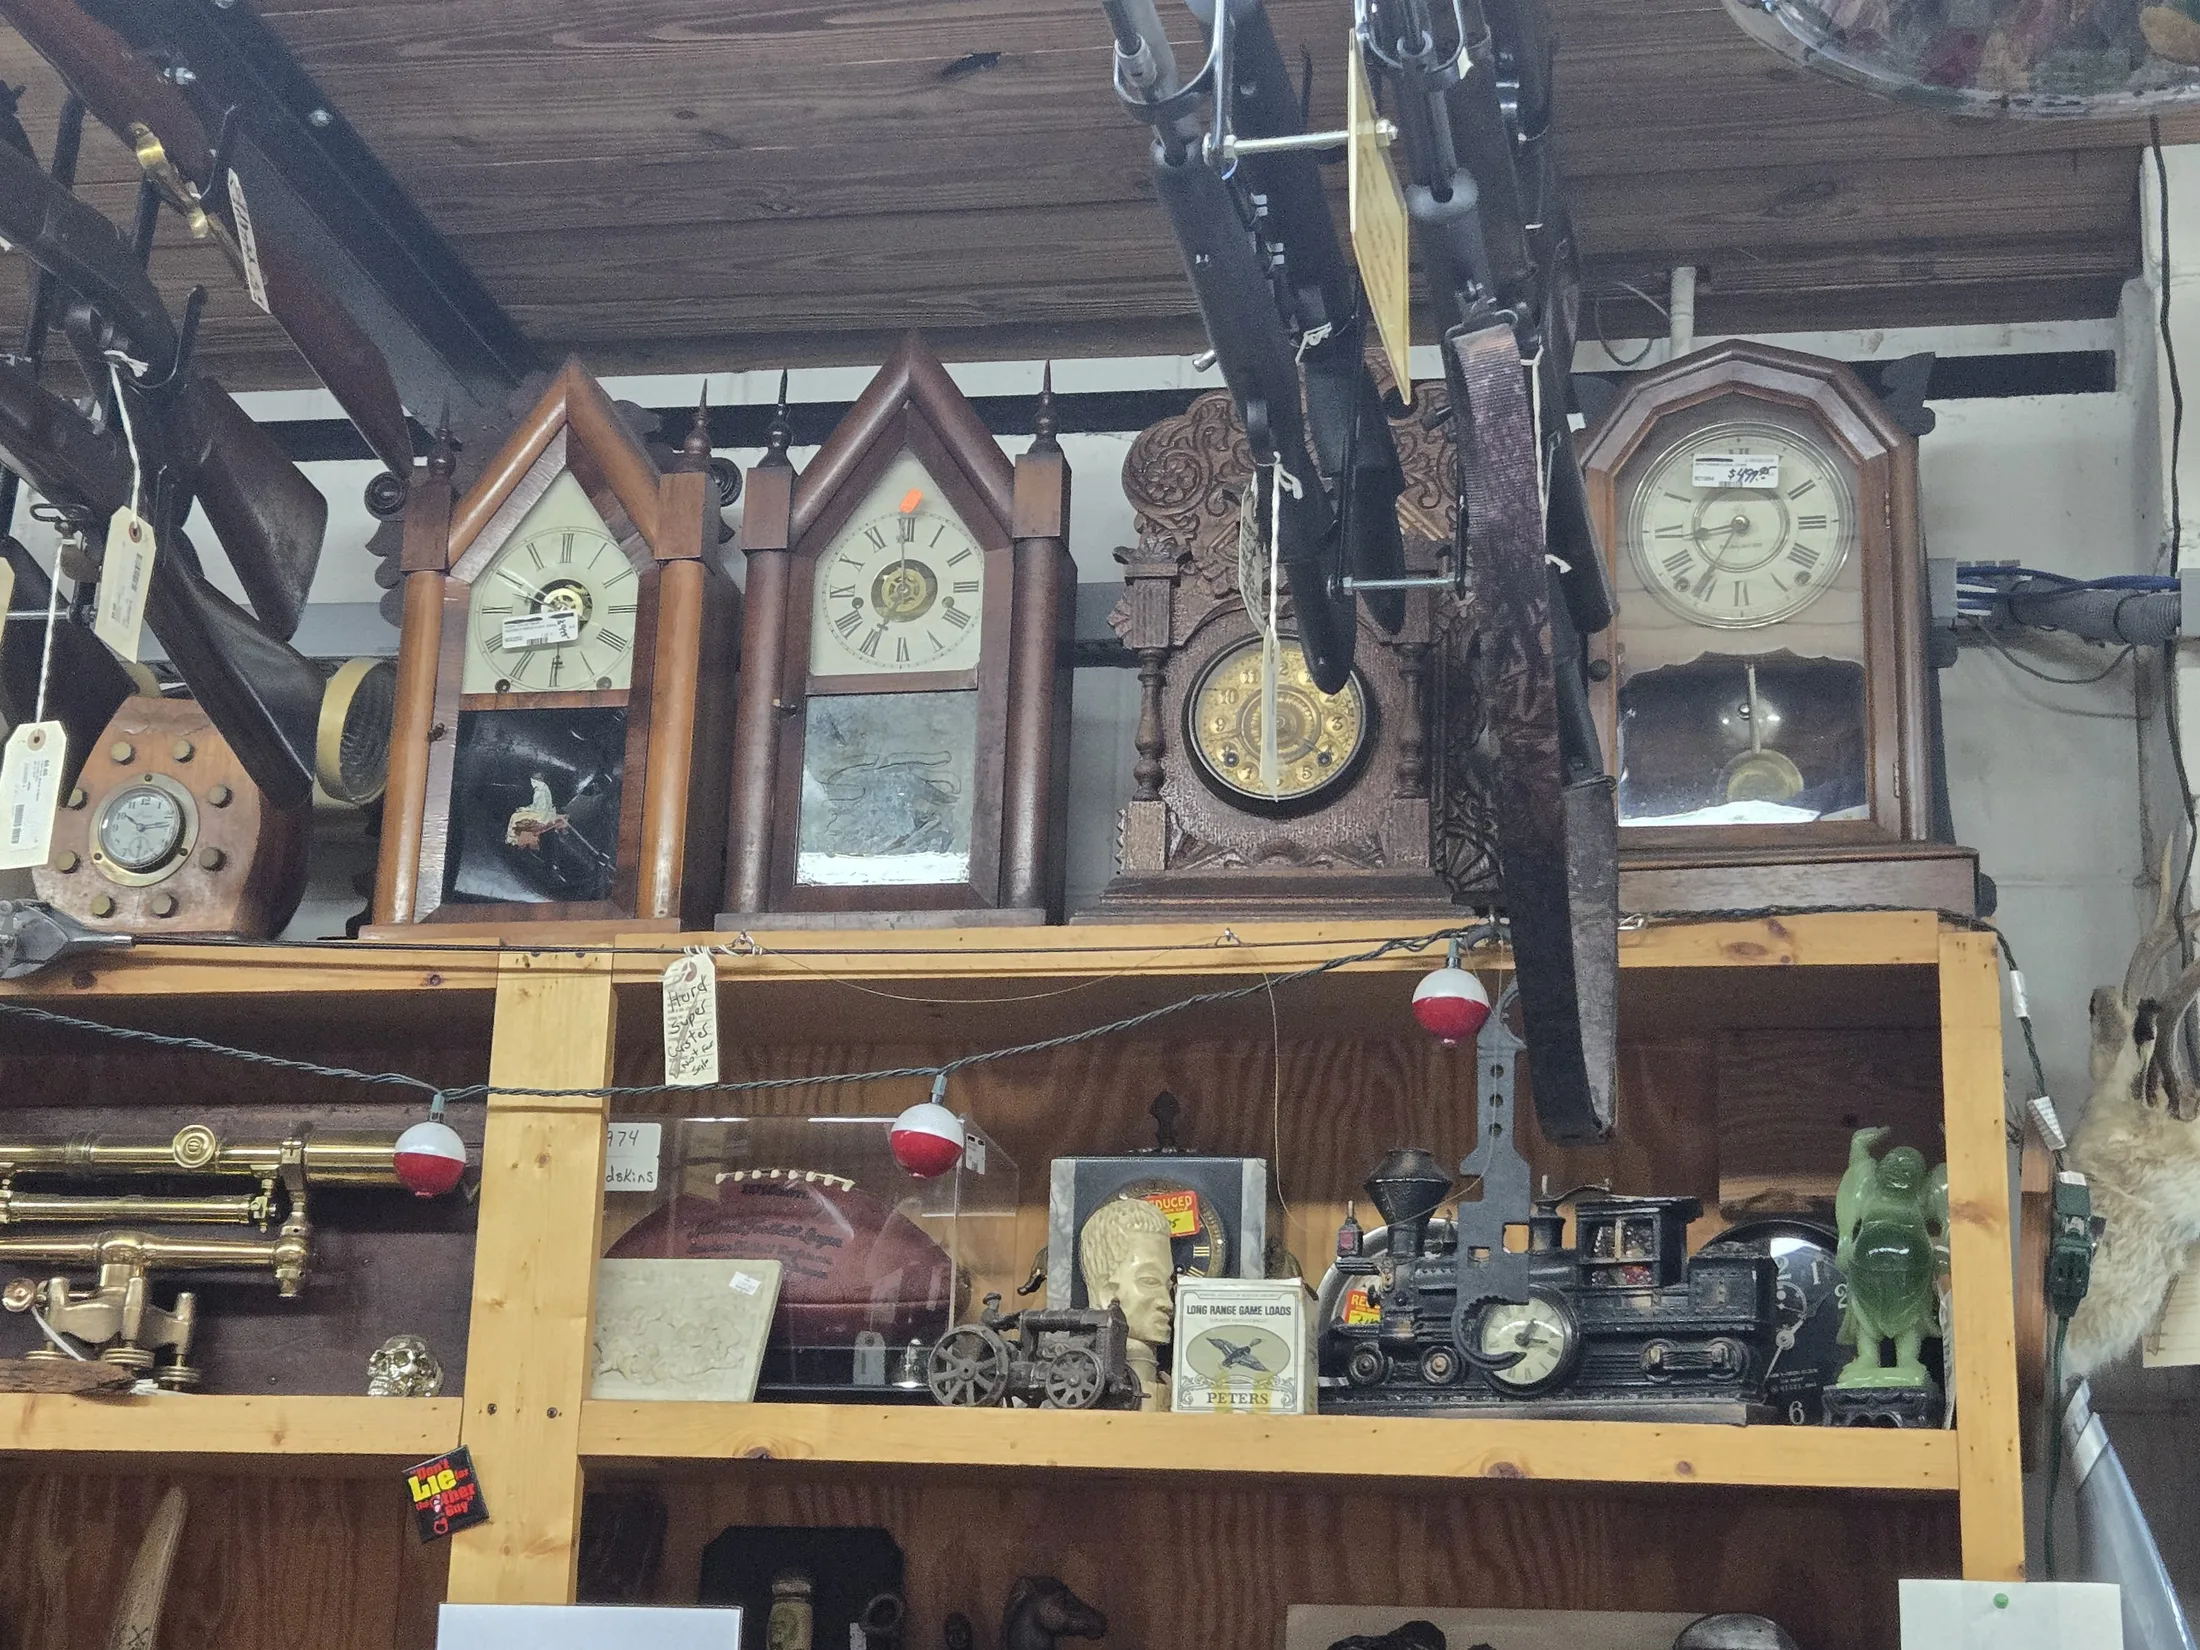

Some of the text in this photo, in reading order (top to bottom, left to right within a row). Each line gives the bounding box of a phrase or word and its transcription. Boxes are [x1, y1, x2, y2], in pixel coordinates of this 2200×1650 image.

[608, 1130, 639, 1147] 974
[606, 1165, 653, 1183] dskins
[1155, 1196, 1192, 1209] DUCED
[1187, 1305, 1292, 1316] LONG RANGE GAME LOADS
[1207, 1392, 1269, 1405] PETERS
